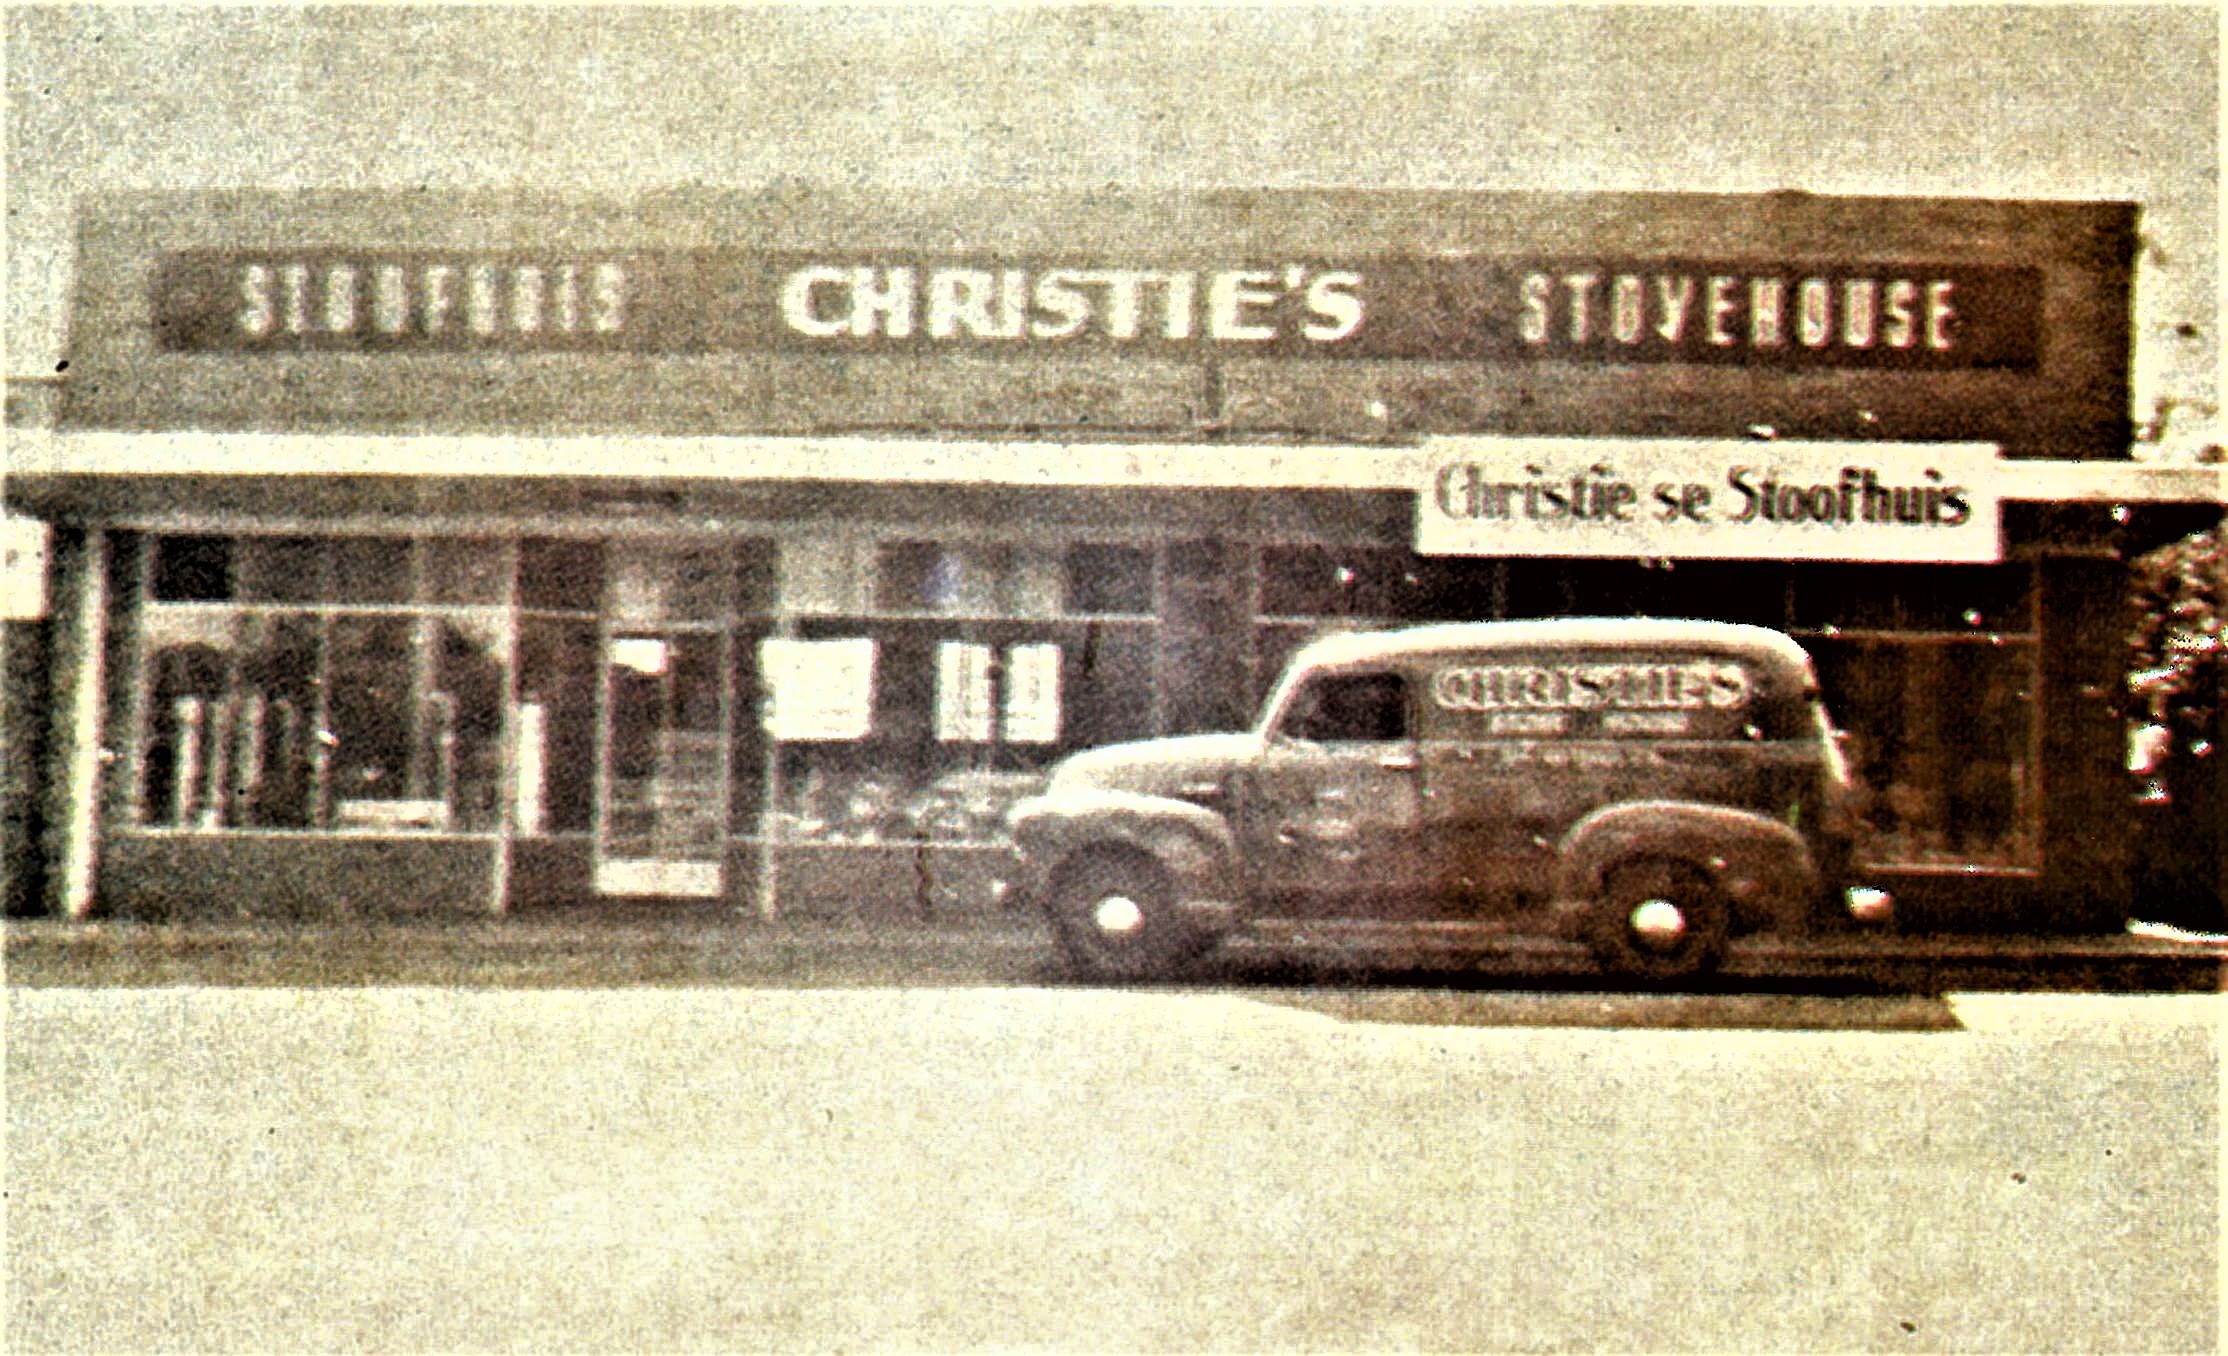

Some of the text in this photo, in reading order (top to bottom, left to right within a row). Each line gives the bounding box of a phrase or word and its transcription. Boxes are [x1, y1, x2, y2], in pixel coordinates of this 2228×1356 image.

[783, 266, 1365, 341] CHRISTIE'S
[1520, 273, 1956, 349] STOVEHOUSE
[1435, 462, 1972, 526] Christie se Stoofhuis
